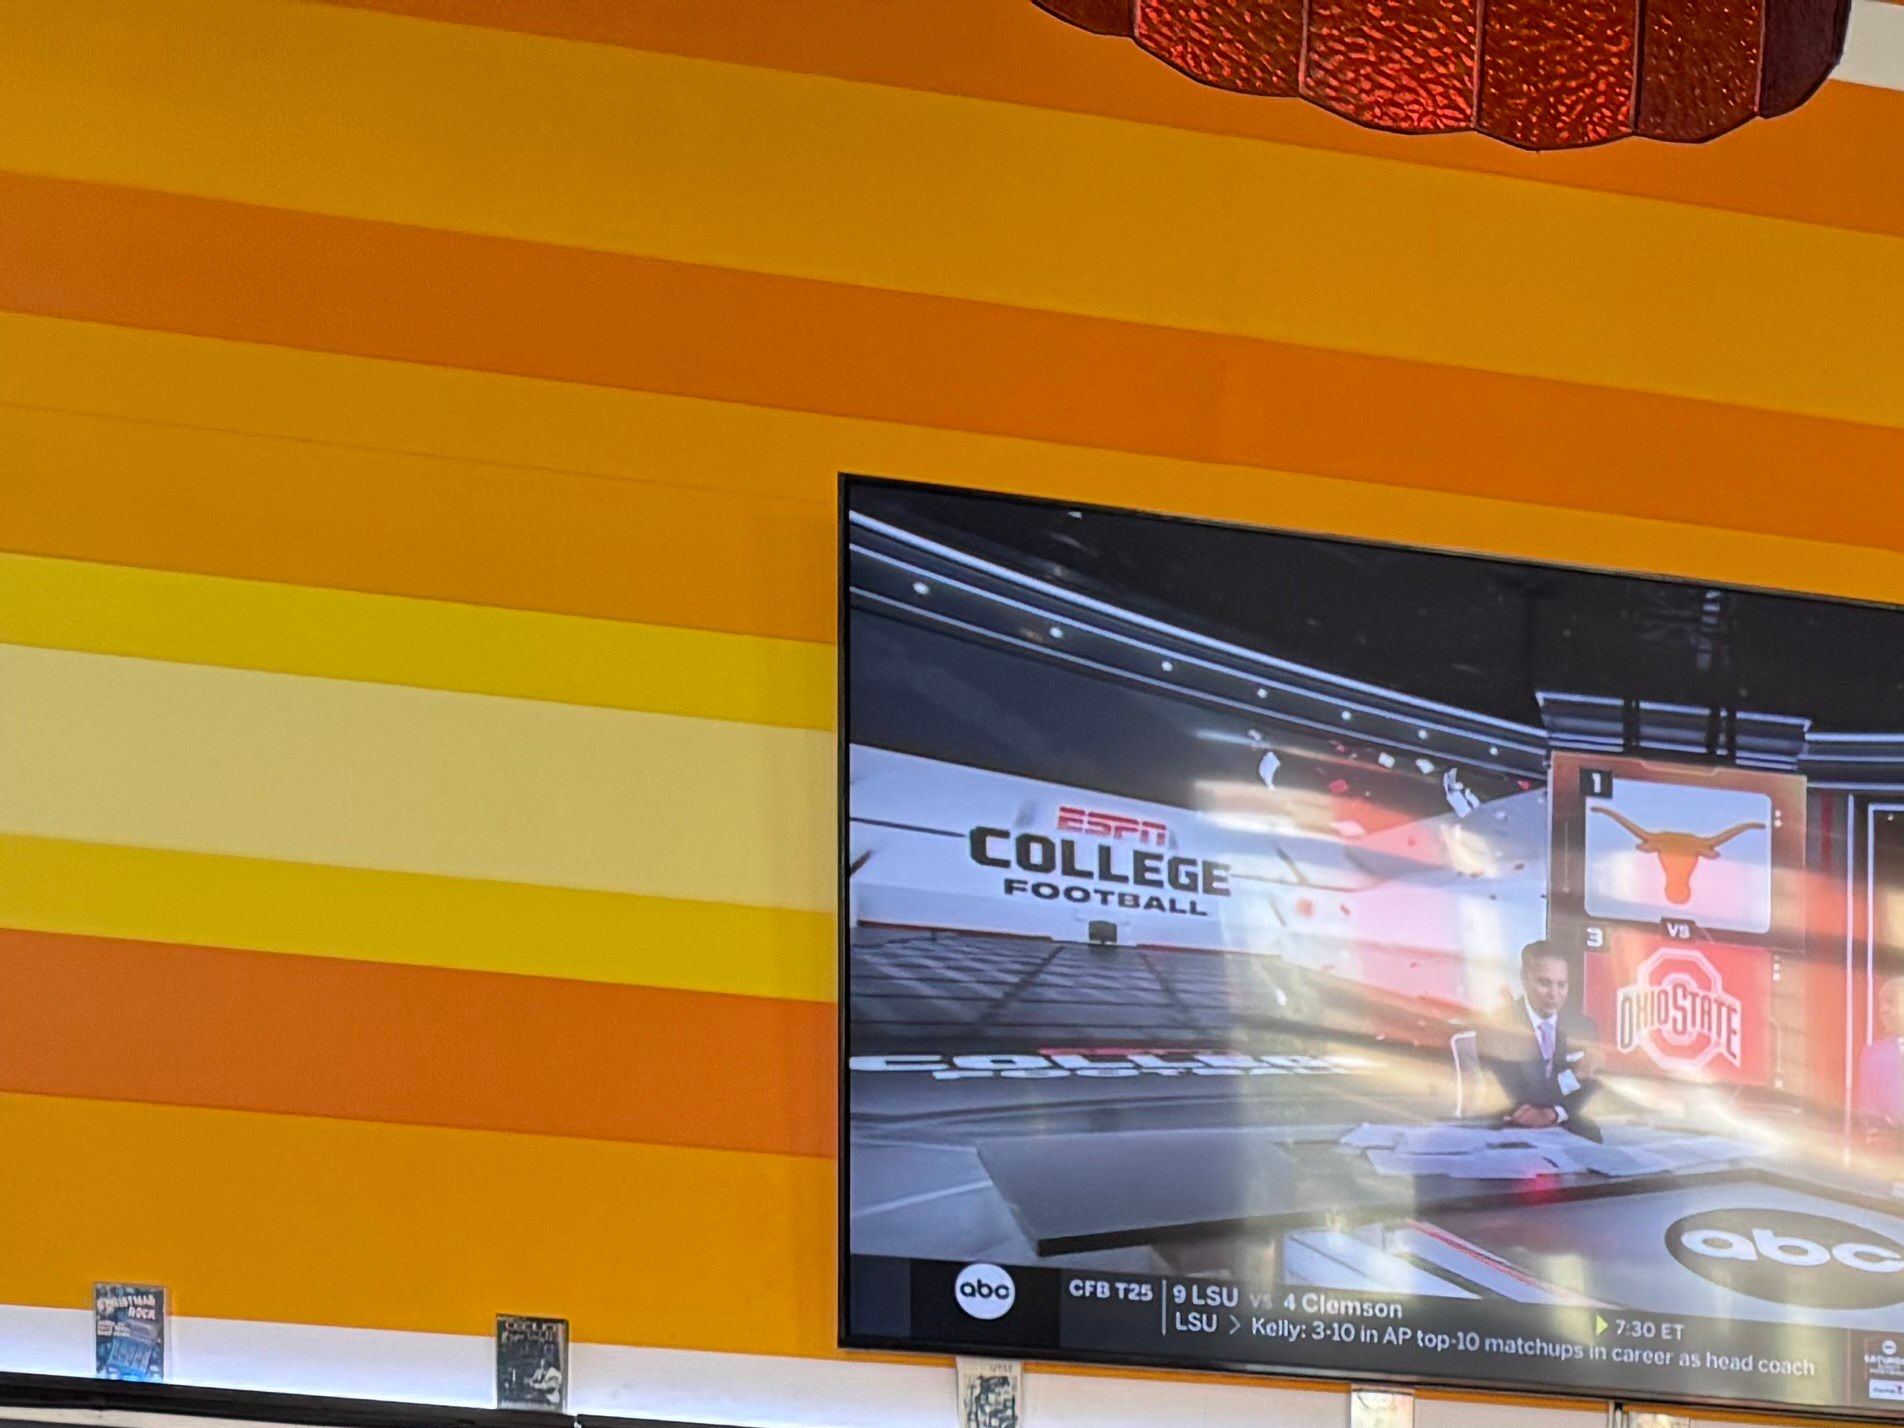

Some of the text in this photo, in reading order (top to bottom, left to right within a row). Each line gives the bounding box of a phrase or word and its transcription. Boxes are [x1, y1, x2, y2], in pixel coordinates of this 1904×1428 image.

[1591, 772, 1601, 794] 1
[1057, 806, 1168, 847] ESPN
[970, 826, 1231, 897] COLLEGE
[1004, 878, 1209, 916] FOOTBALL
[1586, 927, 1603, 947] 3
[1617, 982, 1742, 1066] OHIO STATE
[959, 1279, 1011, 1301] abc
[1069, 1279, 1154, 1301] CFB T25
[1174, 1286, 1187, 1305] 9
[1192, 1288, 1239, 1308] LSU
[1284, 1296, 1297, 1313] 4
[1301, 1294, 1403, 1320] Clemson
[1176, 1312, 1816, 1377] LSU Kelly: 3-10 in AP top-10 matchups in career as head coach
[1615, 1319, 1685, 1341] 7:30 ET
